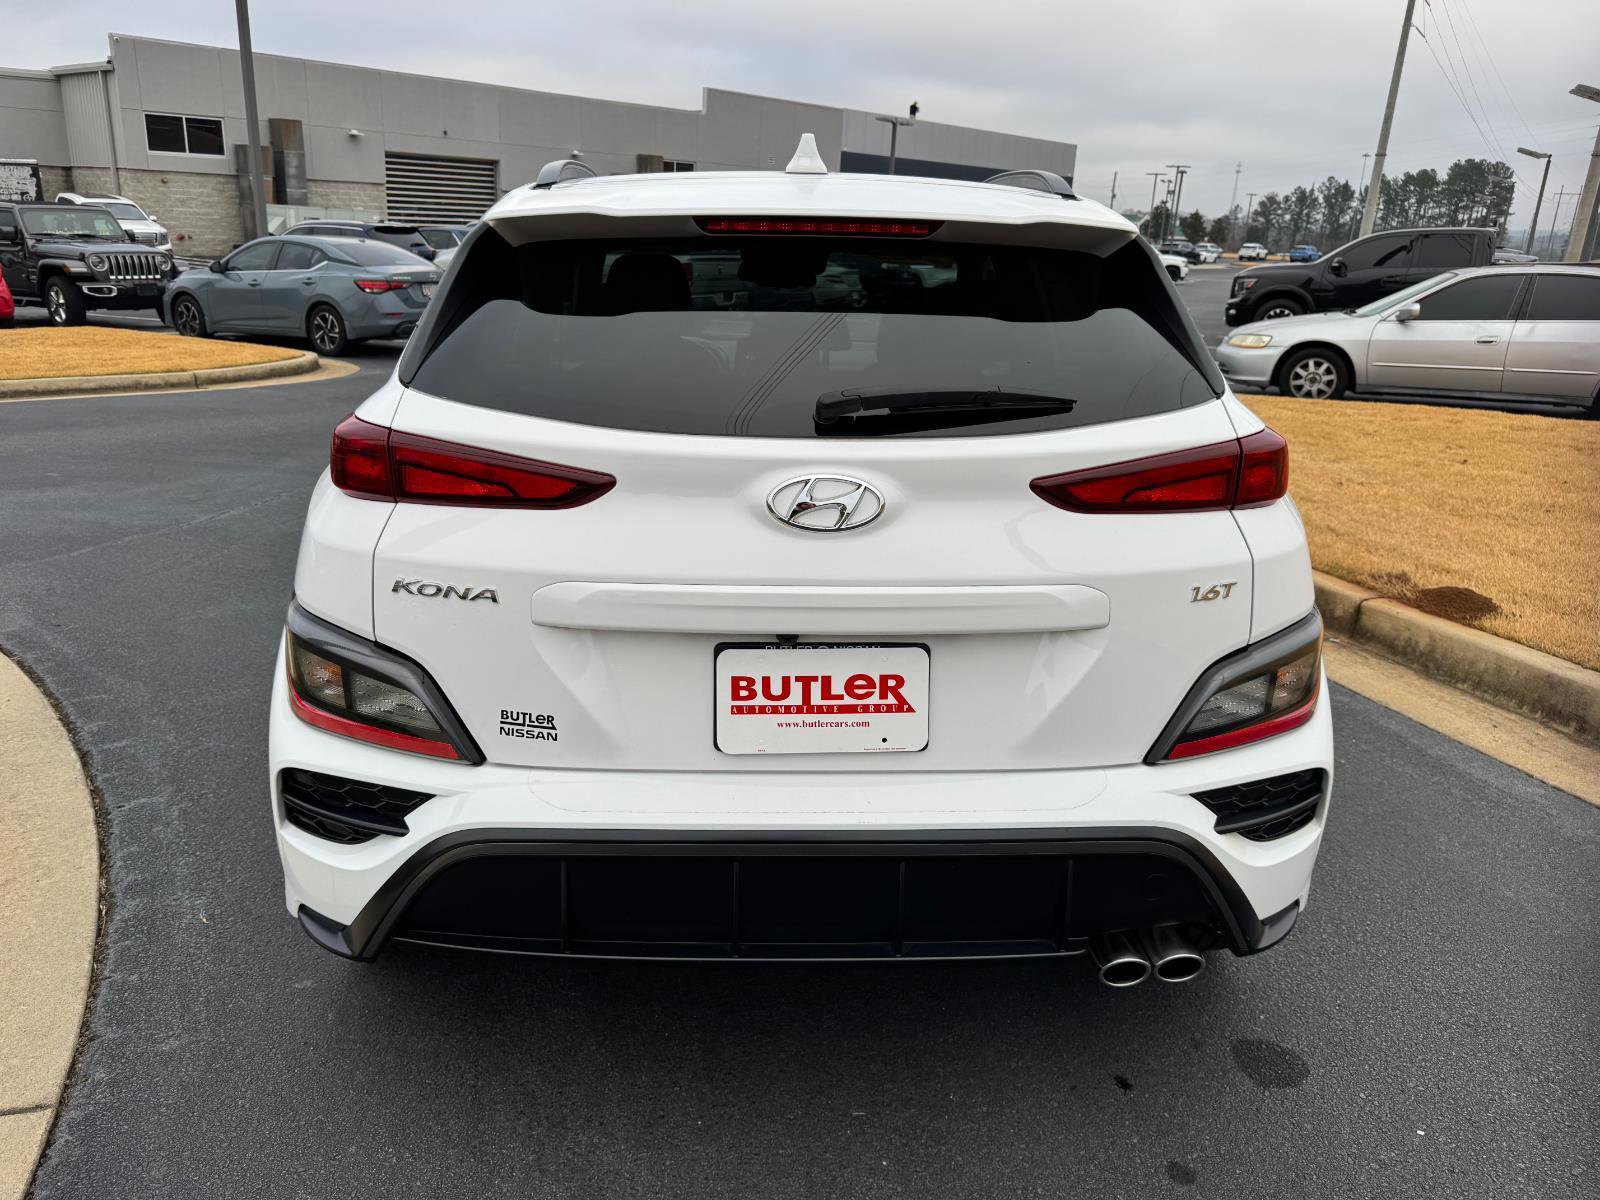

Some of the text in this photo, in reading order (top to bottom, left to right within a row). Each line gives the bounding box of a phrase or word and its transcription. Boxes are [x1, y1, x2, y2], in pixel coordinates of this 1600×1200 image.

[391, 578, 499, 604] KONA
[732, 705, 909, 714] AUTOMOTIVE GROUP
[776, 719, 870, 728] www.butlercars.com
[499, 726, 558, 741] NISSAN
